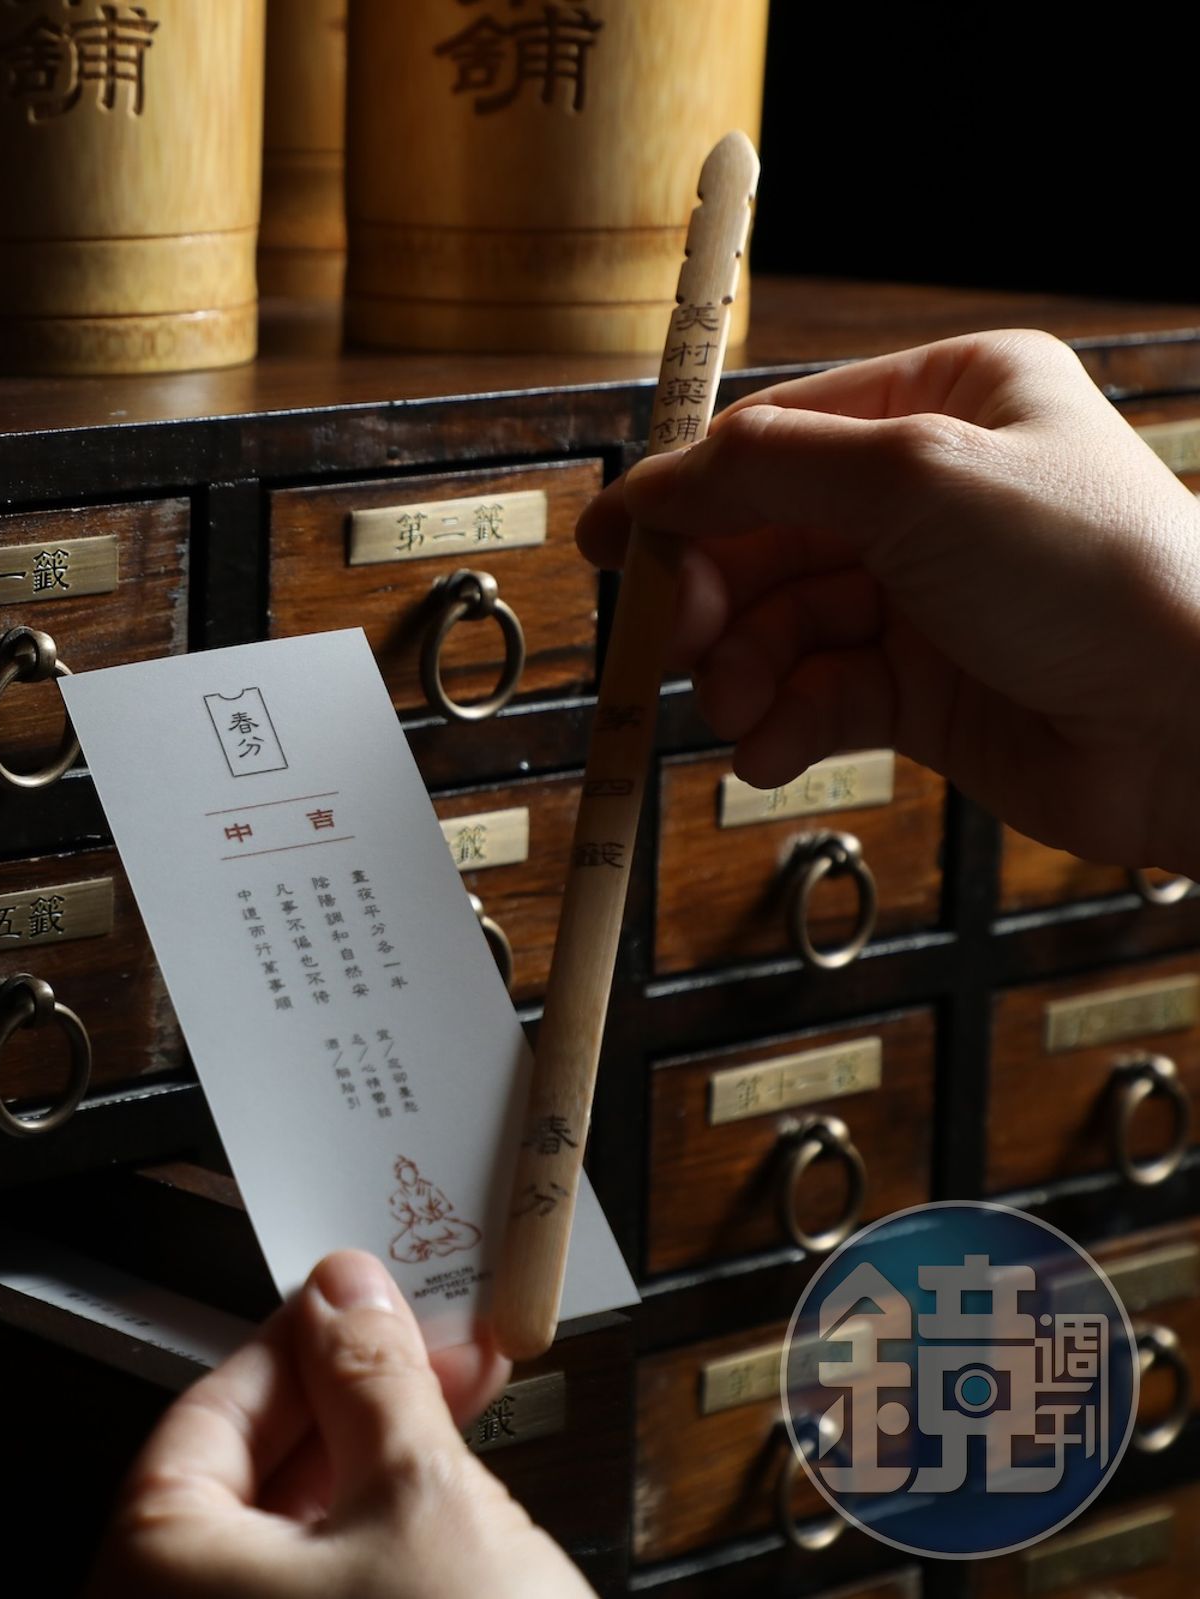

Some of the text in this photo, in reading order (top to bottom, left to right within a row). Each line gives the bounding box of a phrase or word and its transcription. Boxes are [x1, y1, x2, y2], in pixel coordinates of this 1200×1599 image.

[433, 0, 603, 116] 舖
[395, 504, 504, 552] 第二籤
[228, 711, 265, 758] 春分
[510, 1114, 578, 1219] 春分
[467, 1395, 516, 1444] 籤
